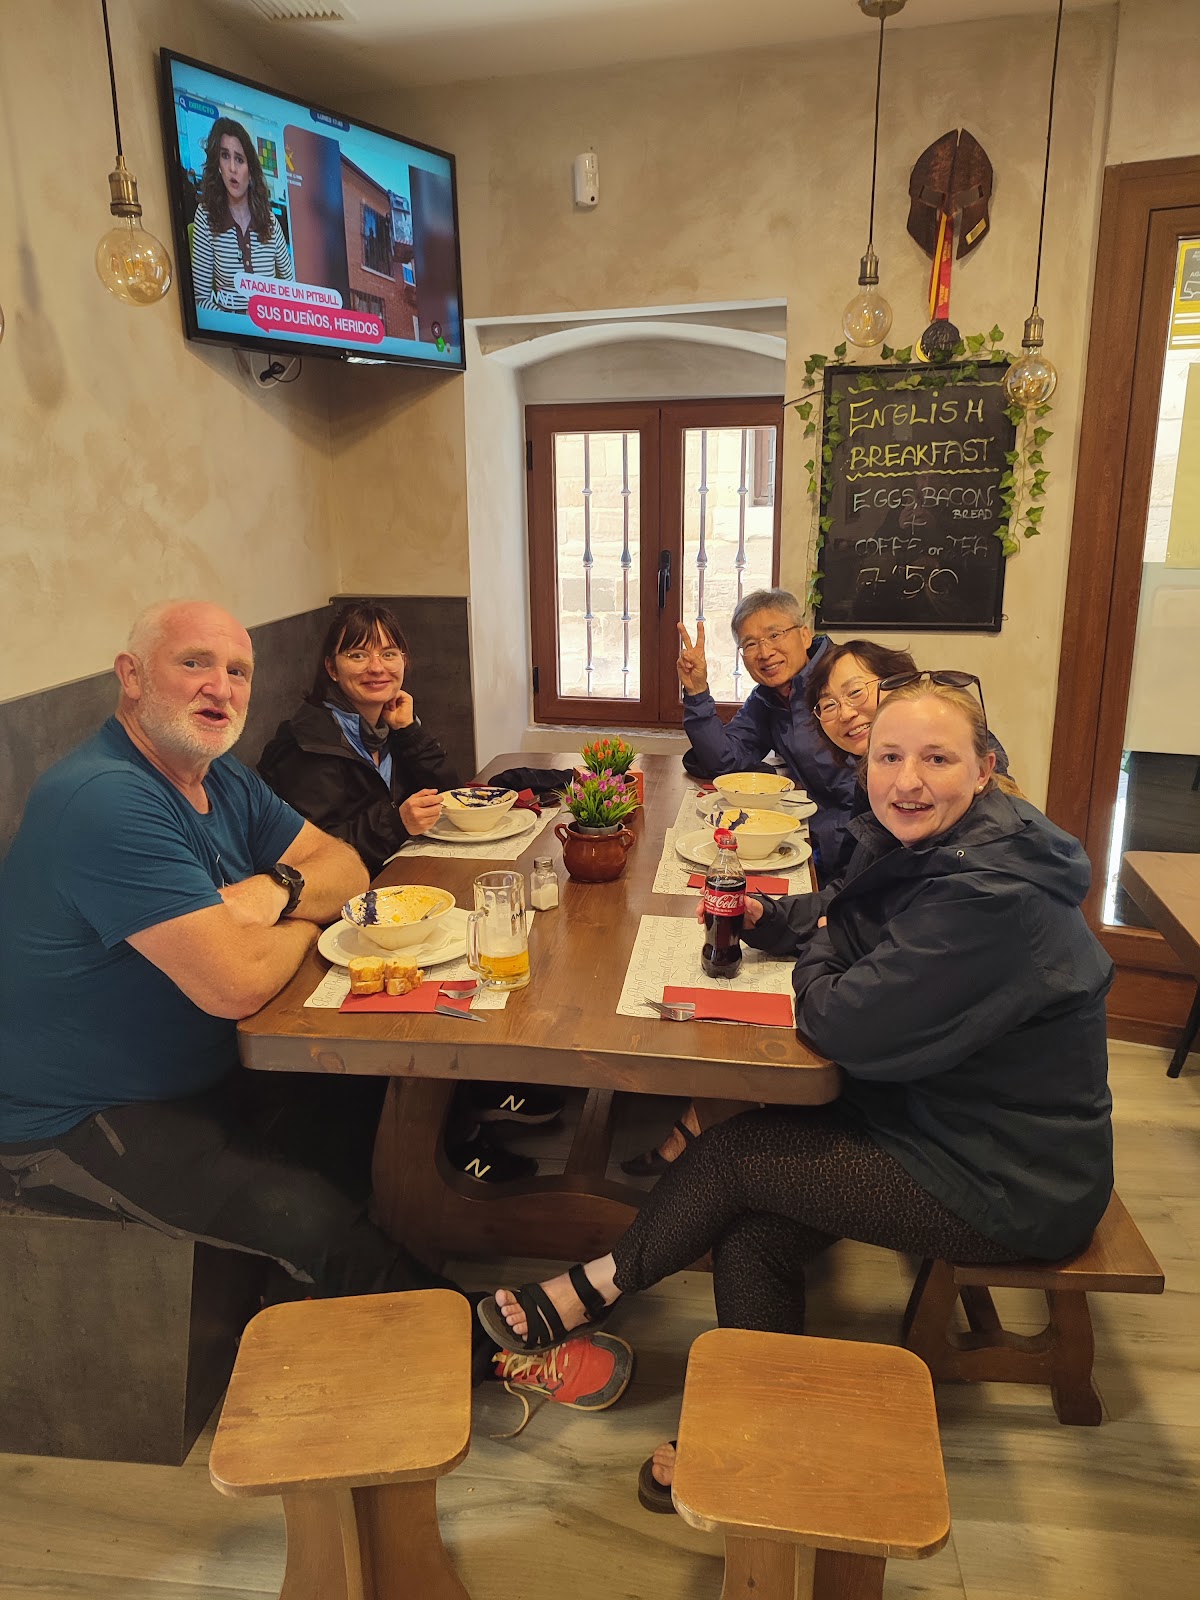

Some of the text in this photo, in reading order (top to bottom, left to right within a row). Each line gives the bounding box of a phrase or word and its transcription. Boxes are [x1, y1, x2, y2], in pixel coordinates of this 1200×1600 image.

[239, 278, 339, 306] ATAQUE DE UN PITBULL
[256, 304, 379, 336] SUS DUEÑOS, HERIDOS
[850, 436, 995, 470] BREAKFAST
[952, 509, 993, 521] BREAD
[928, 546, 944, 556] or
[500, 1094, 526, 1112] N
[464, 1157, 492, 1178] N
